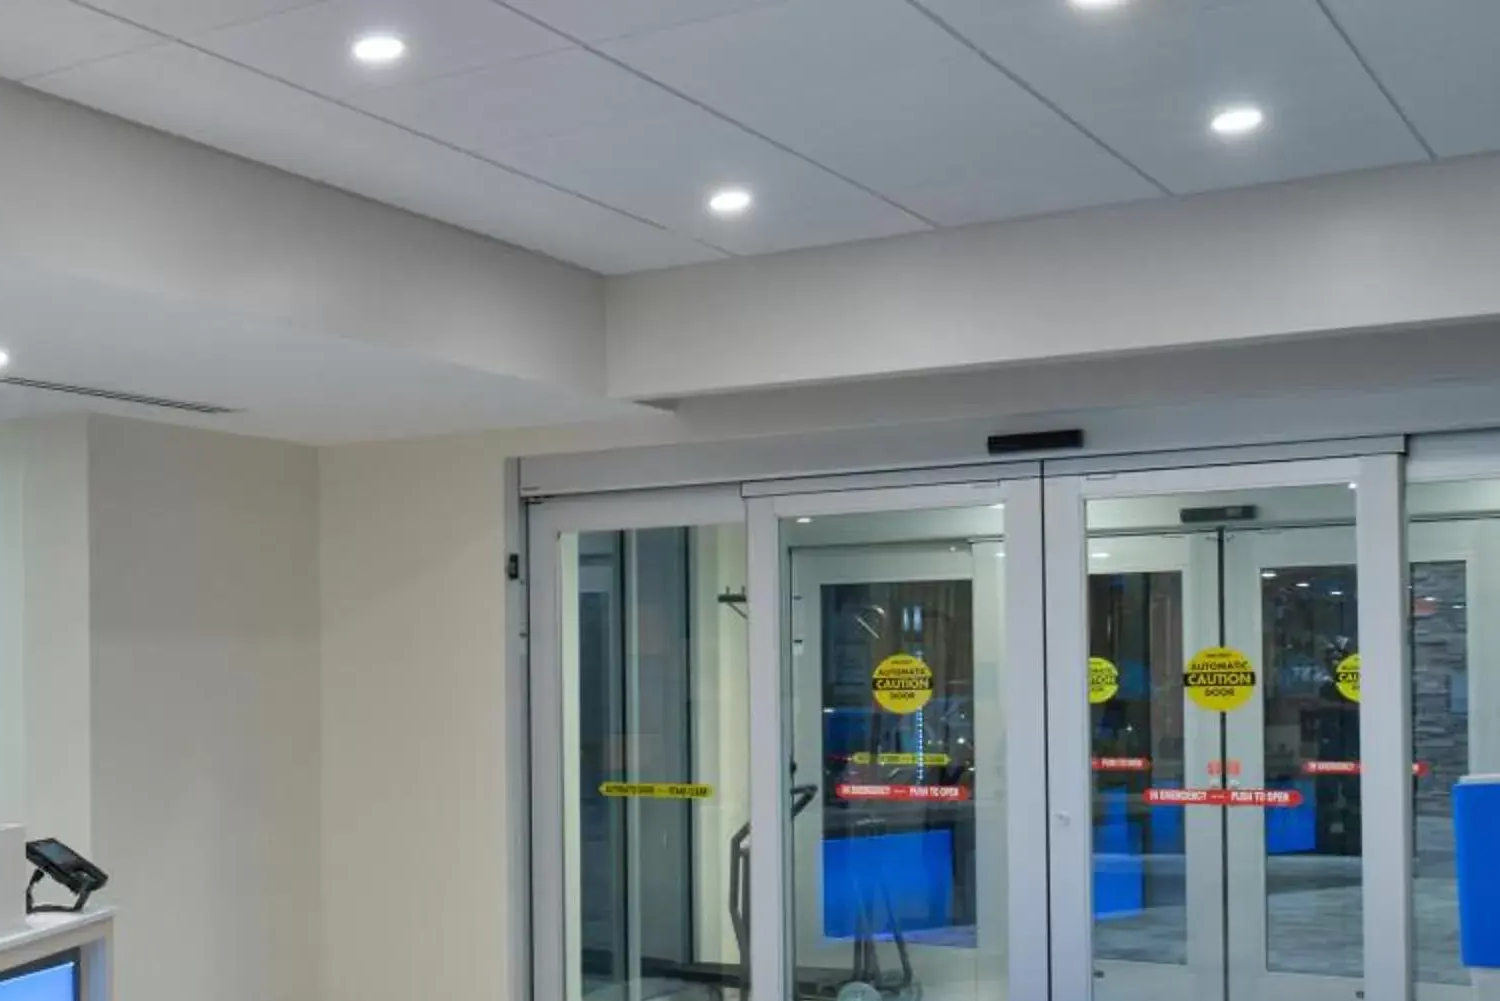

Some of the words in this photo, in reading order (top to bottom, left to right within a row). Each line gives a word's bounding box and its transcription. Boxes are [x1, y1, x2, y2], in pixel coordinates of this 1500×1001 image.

[1189, 660, 1249, 671] AUTOMATIC
[875, 679, 929, 689] CAUTION
[1187, 673, 1251, 685] CAUTION
[1204, 687, 1235, 697] DOOR
[1231, 791, 1253, 801] PUSH
